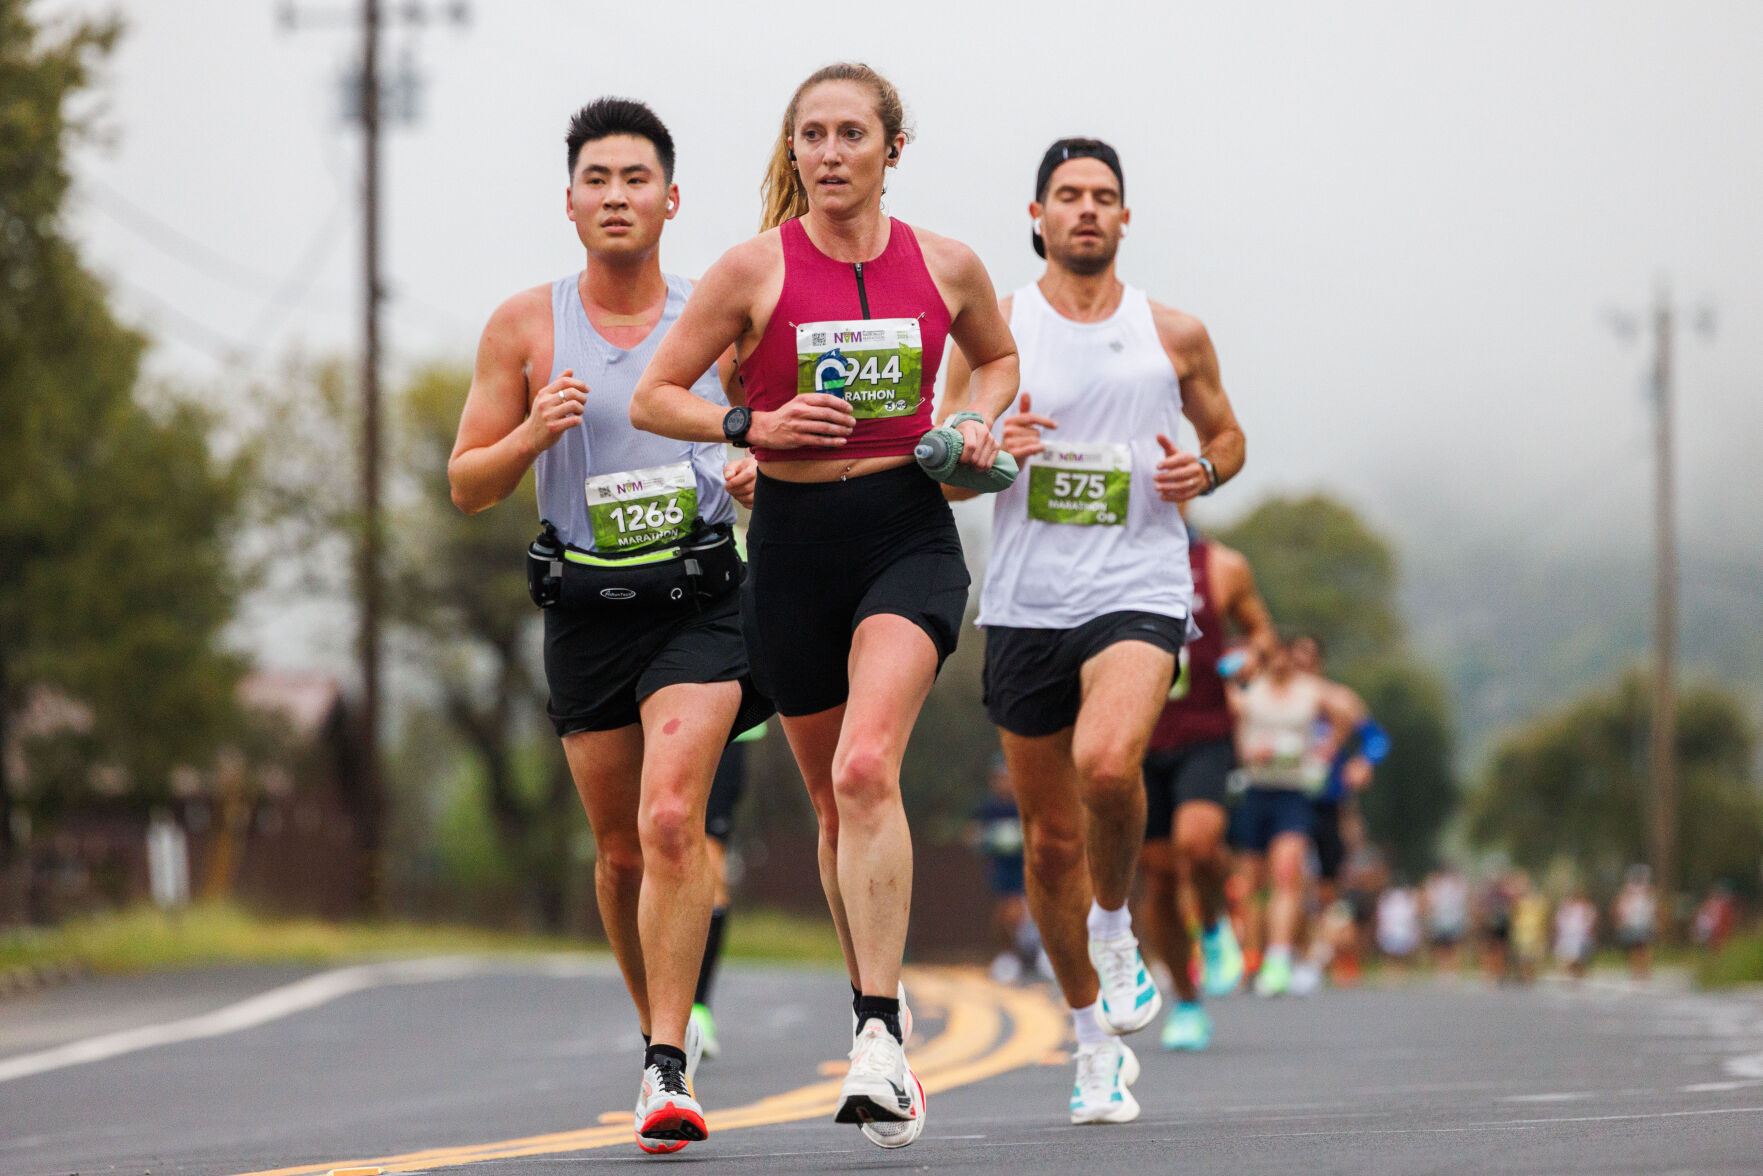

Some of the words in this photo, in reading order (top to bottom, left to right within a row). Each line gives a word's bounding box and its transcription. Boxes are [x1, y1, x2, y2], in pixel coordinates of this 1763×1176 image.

[834, 329, 862, 343] NVM
[844, 355, 903, 386] 944
[843, 389, 895, 401] RATHON
[617, 480, 643, 494] NVM
[1053, 472, 1106, 499] 575
[610, 498, 684, 533] 1266
[618, 528, 679, 546] MARATHON
